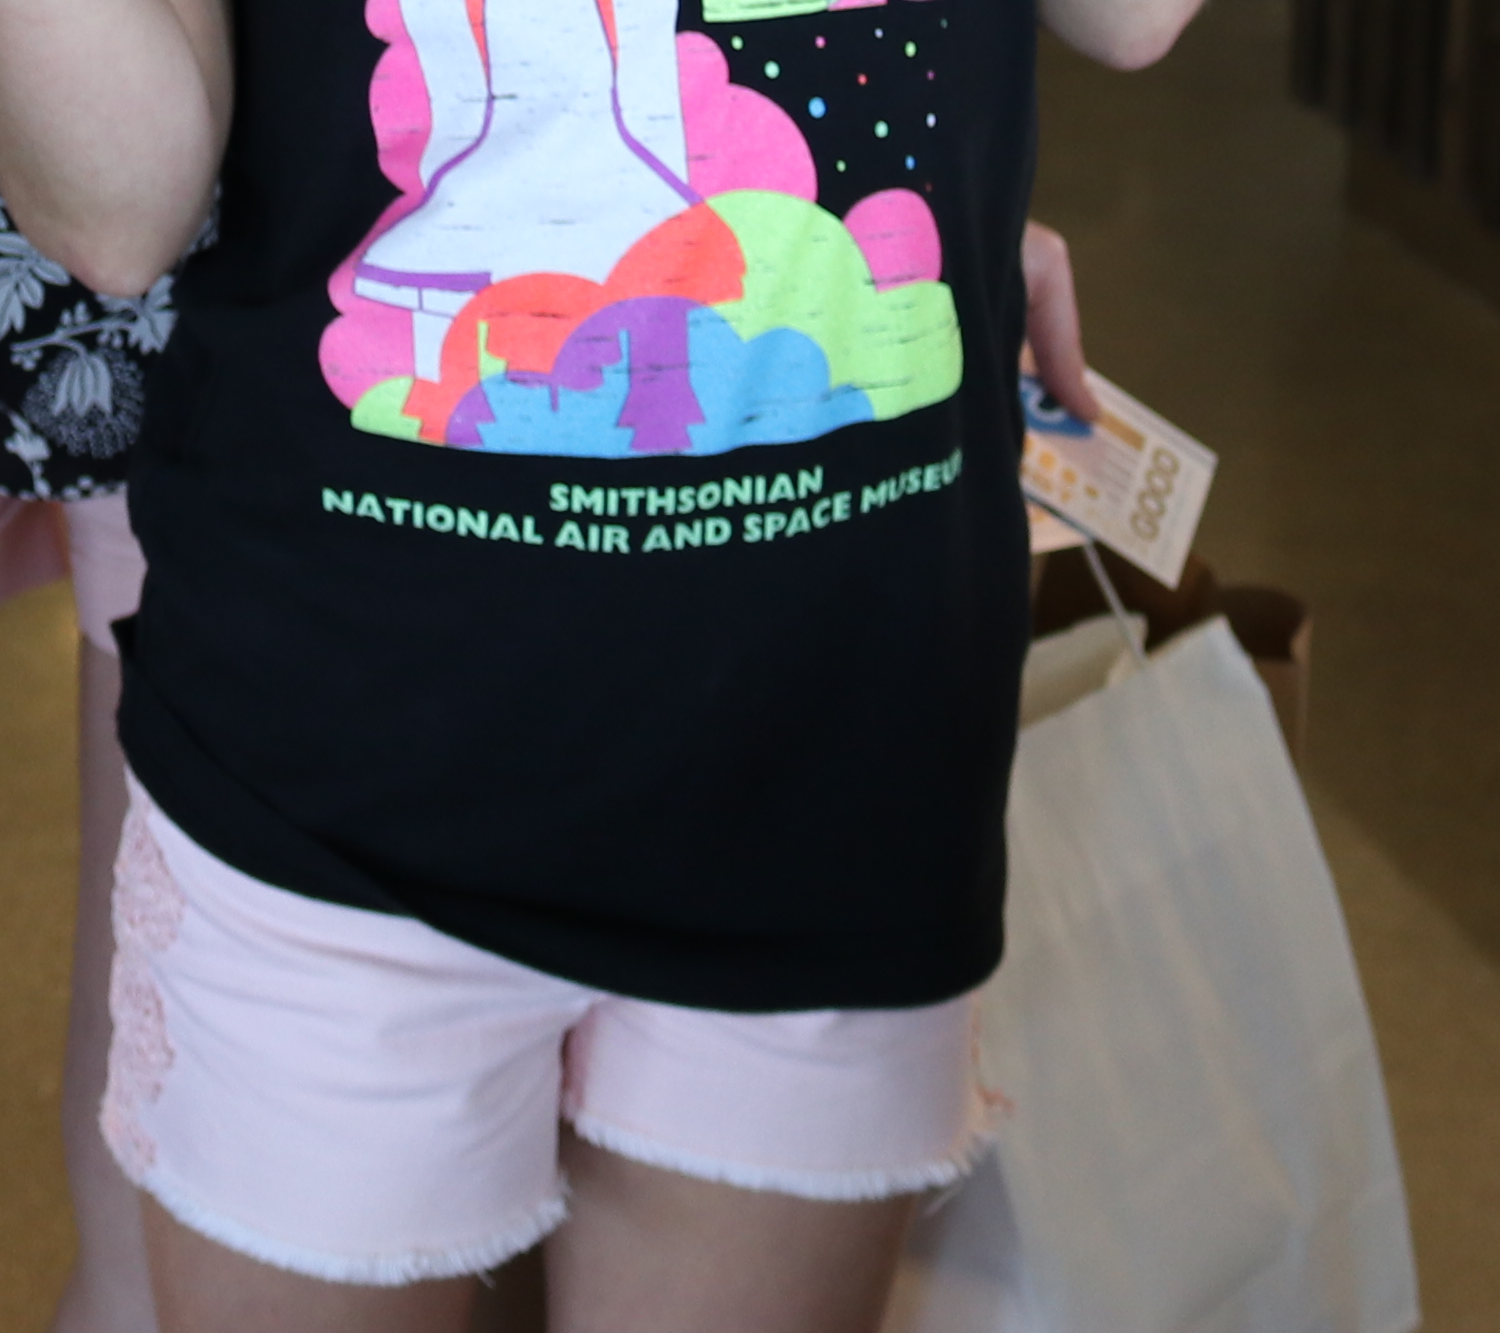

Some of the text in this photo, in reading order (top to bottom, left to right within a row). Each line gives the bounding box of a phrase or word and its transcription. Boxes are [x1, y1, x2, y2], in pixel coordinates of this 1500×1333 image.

[321, 487, 544, 546] NATIONAL
[554, 519, 631, 555] AIR
[641, 515, 733, 553] AND
[741, 490, 852, 543] SPACE
[859, 446, 964, 514] MUSEU
[549, 464, 824, 517] SMITHSONIAN
